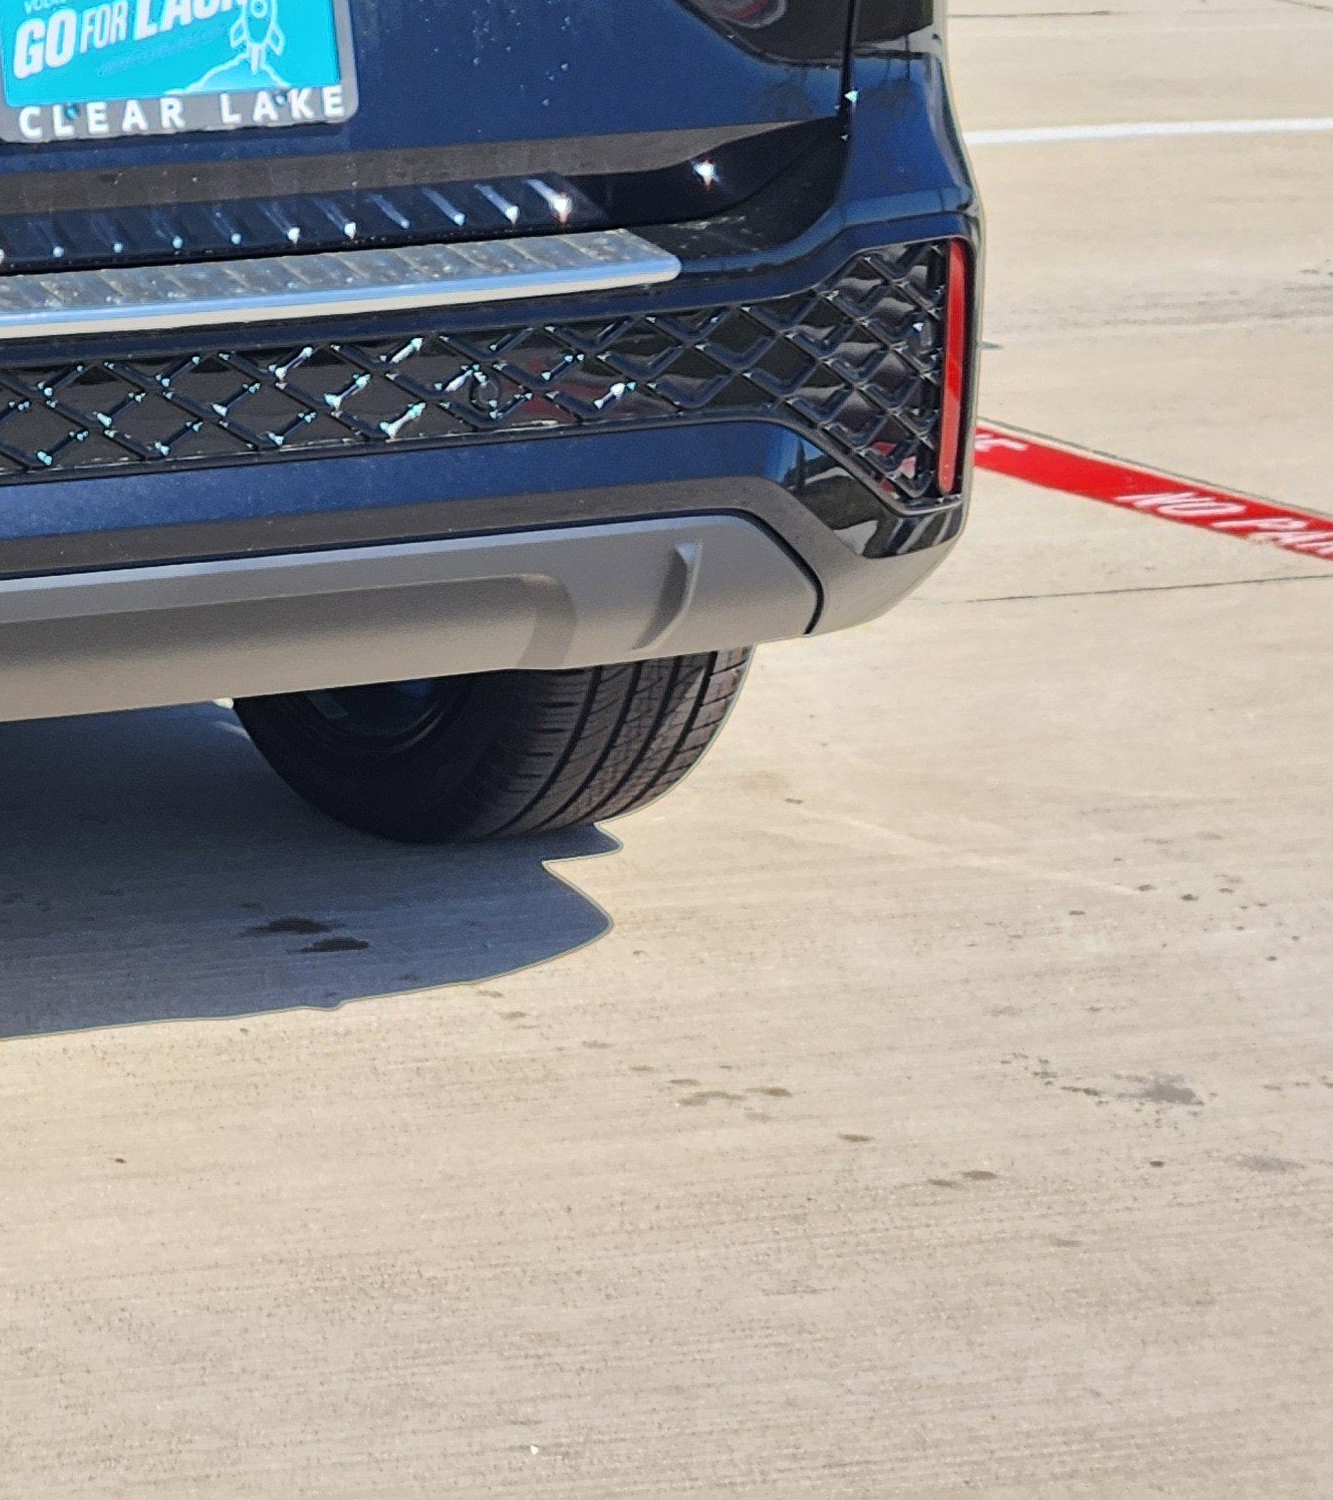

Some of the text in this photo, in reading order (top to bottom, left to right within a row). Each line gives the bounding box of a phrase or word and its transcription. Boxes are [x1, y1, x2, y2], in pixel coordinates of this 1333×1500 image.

[13, 10, 78, 79] GO
[18, 85, 345, 140] CLEAR LAKE
[1114, 492, 1247, 517] NO
